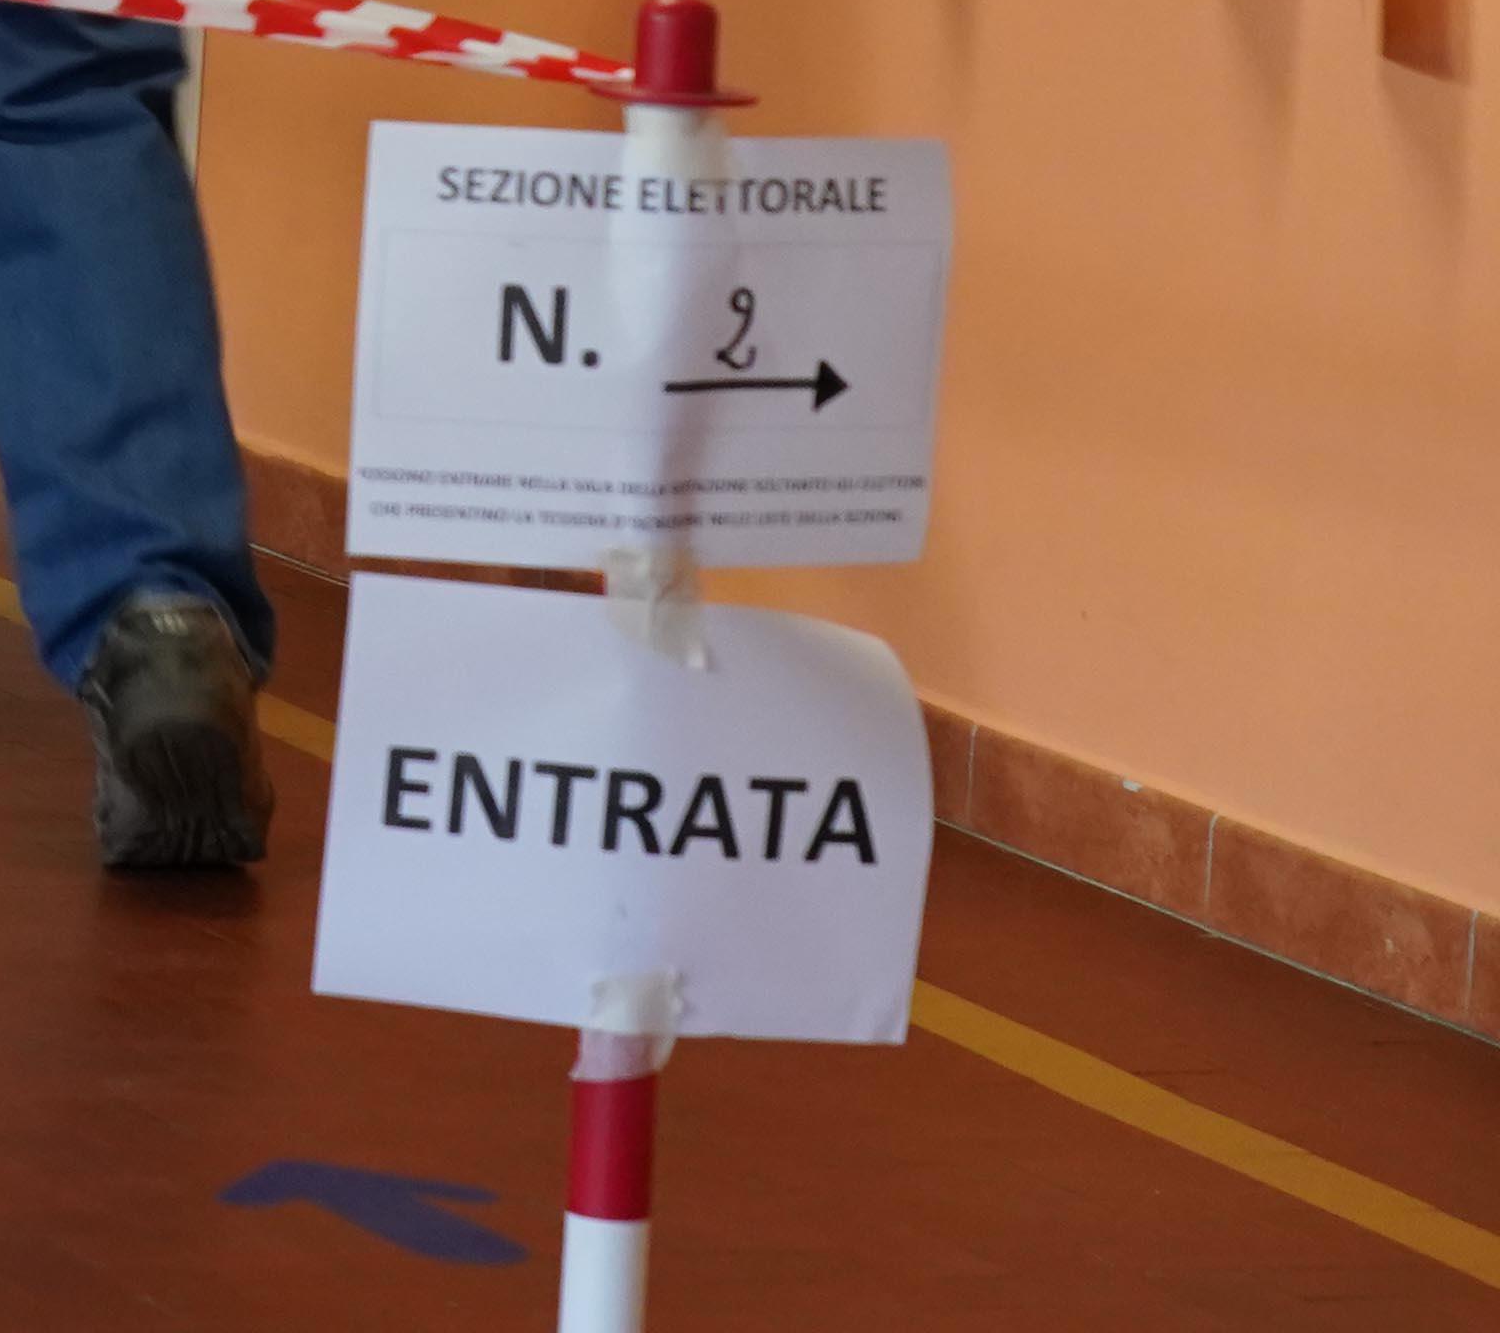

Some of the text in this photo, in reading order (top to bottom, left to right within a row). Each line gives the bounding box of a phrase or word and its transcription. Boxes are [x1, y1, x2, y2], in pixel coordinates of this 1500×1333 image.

[437, 166, 888, 215] SEZIONE ELETTORALE
[498, 282, 757, 371] N. 2
[381, 744, 878, 867] ENTRATA
